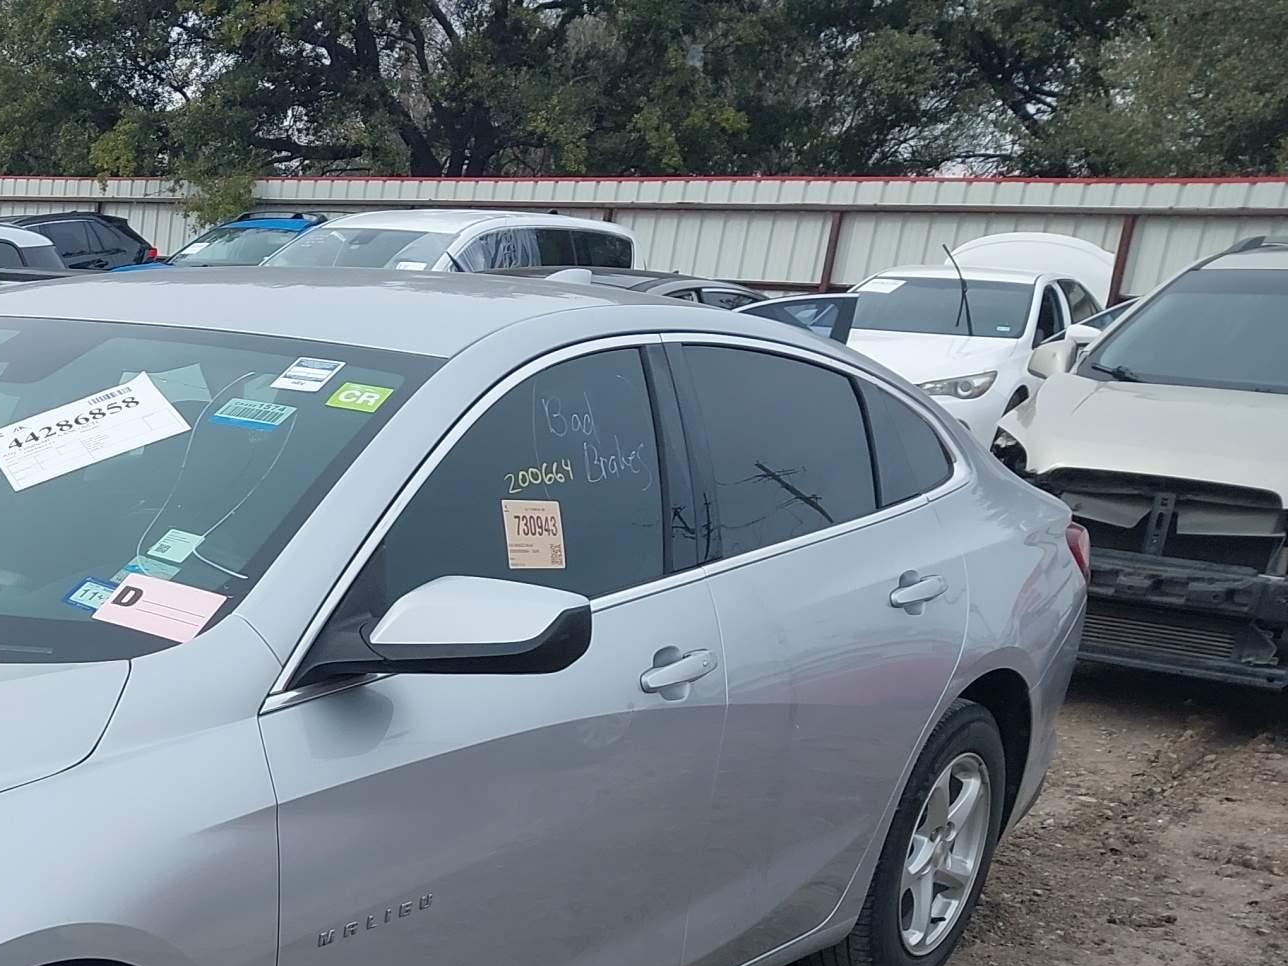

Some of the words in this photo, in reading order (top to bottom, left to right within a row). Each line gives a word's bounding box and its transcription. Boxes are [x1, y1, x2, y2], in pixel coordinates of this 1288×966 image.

[338, 390, 381, 406] CR
[7, 396, 141, 450] 44286858
[541, 391, 600, 444] Bad
[503, 458, 574, 494] 200664
[513, 515, 558, 536] 730943
[112, 585, 144, 607] D
[317, 893, 433, 947] MALIBU
